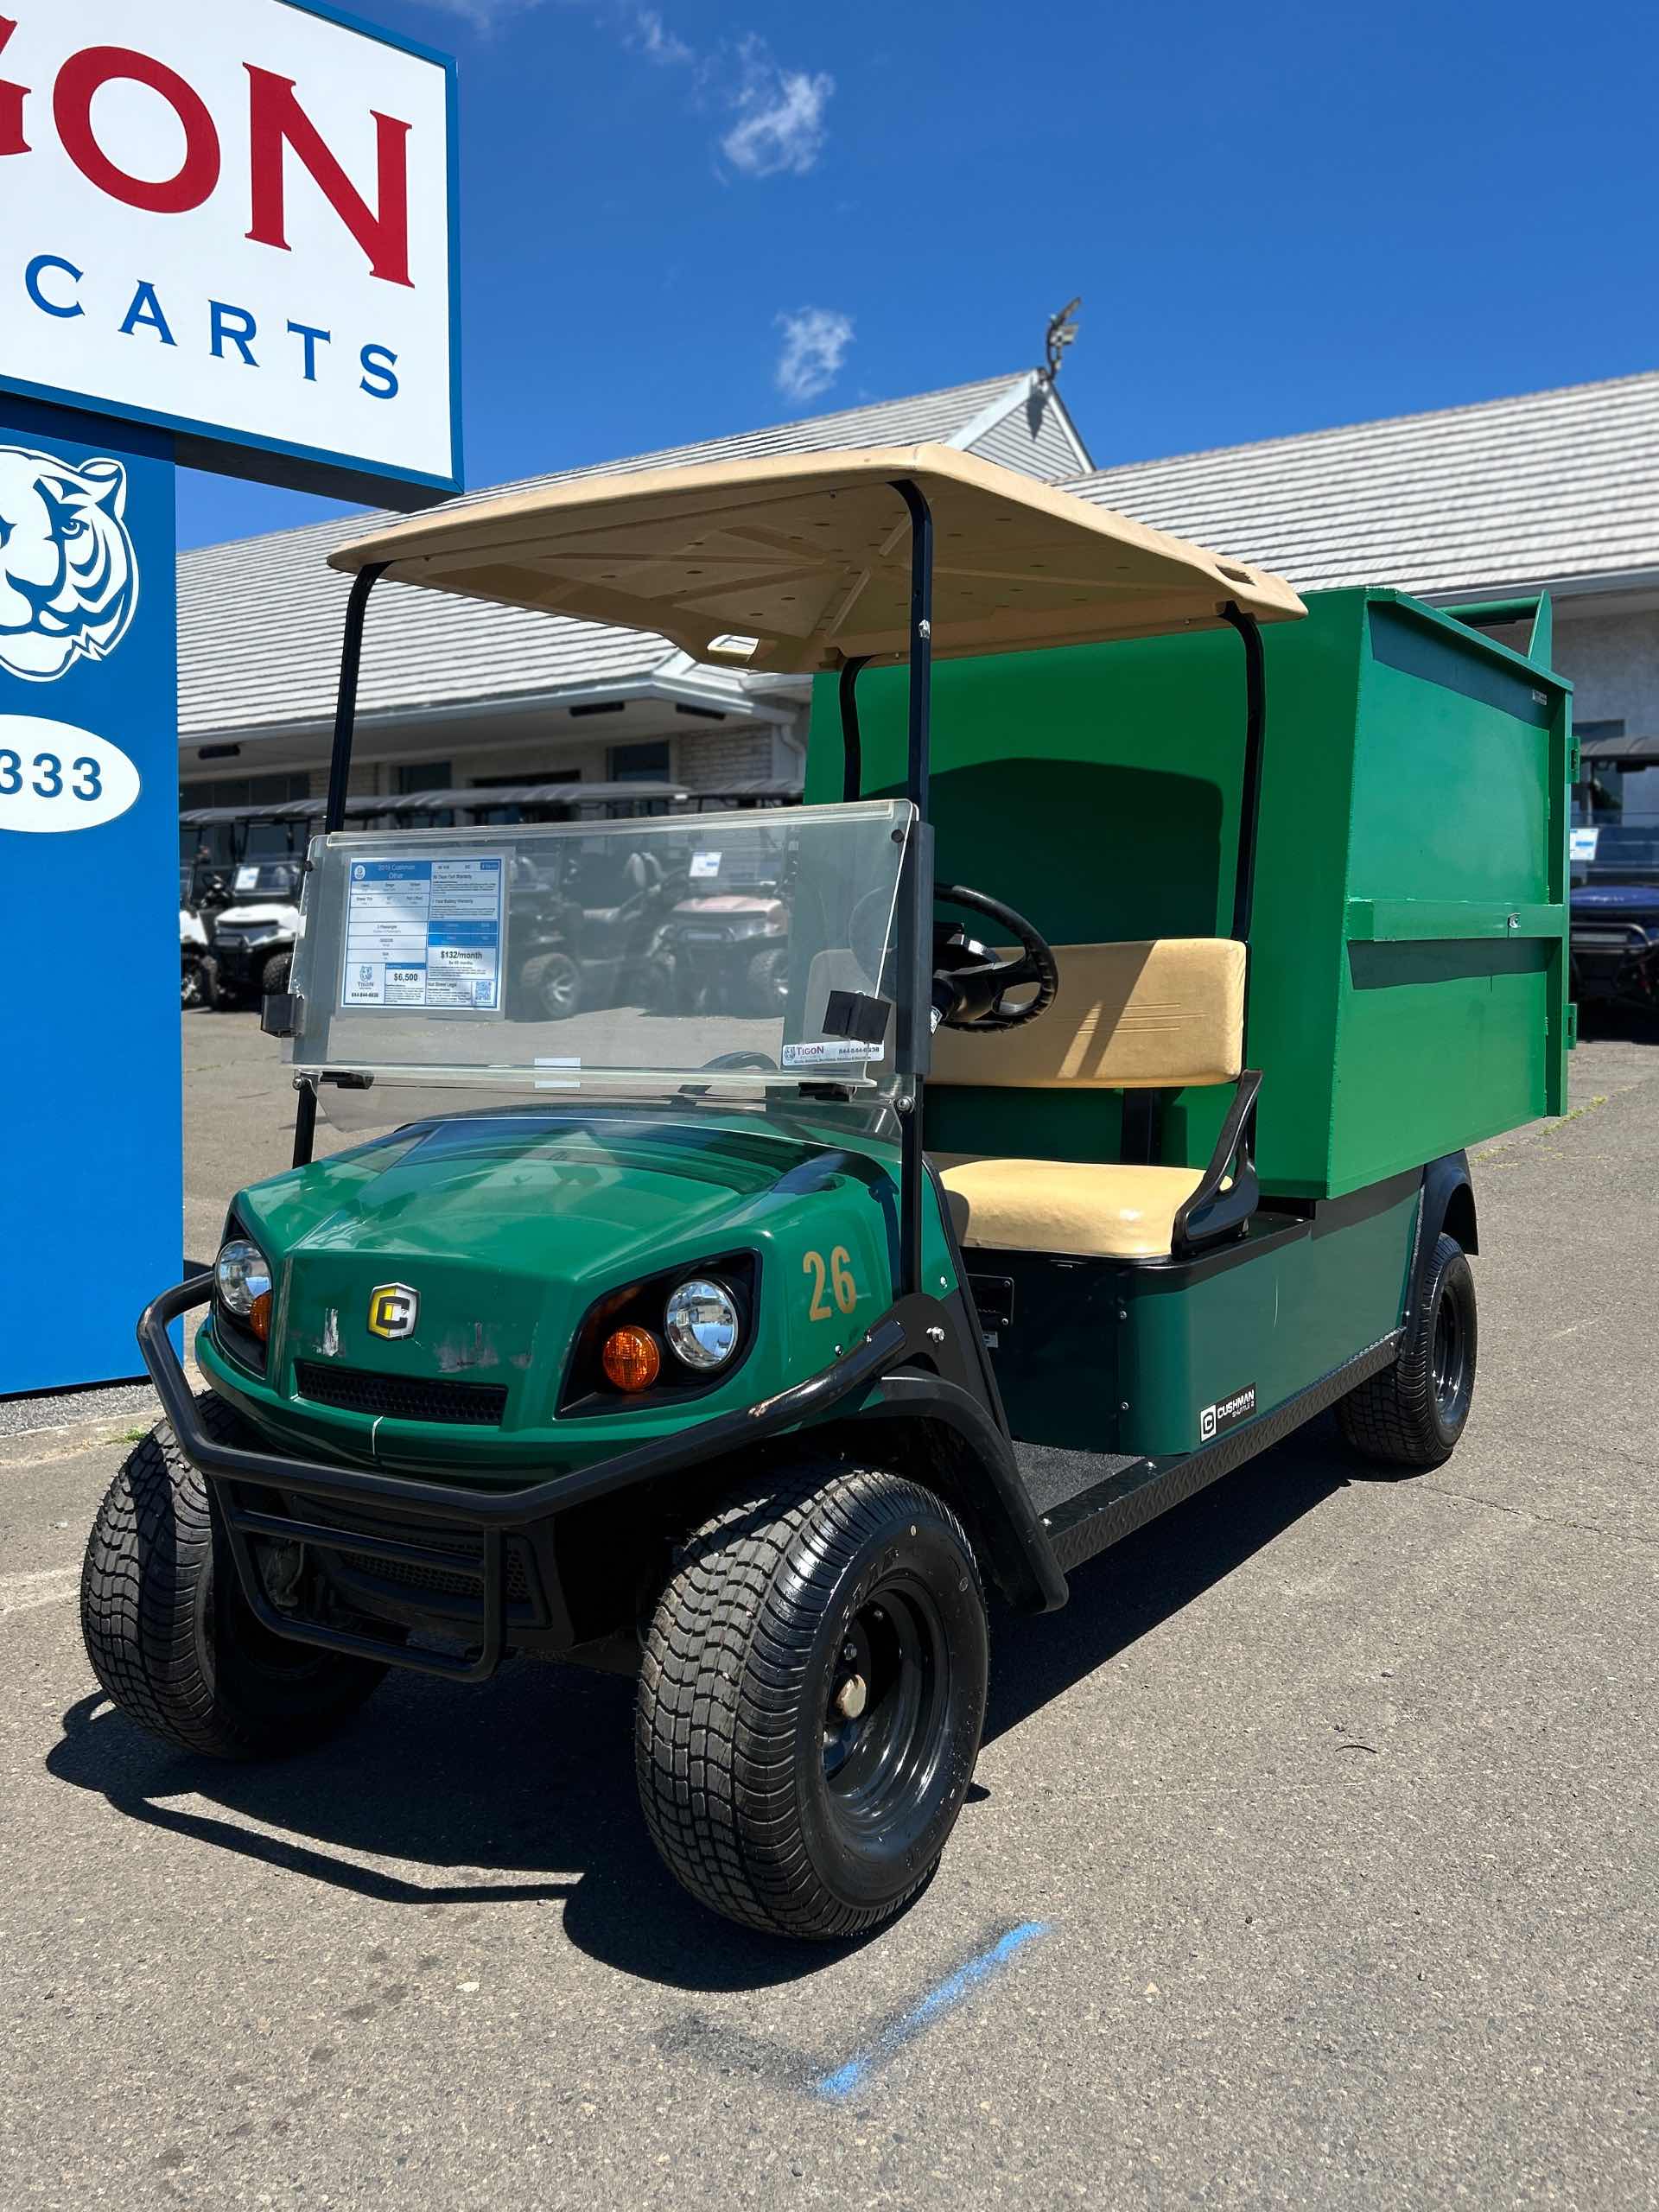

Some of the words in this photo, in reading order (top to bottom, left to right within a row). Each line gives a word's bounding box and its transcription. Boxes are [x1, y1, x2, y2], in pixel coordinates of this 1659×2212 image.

[0, 16, 415, 289] ON
[25, 254, 399, 399] CARTS
[441, 950, 483, 960] $132/month
[393, 973, 418, 982] $6,500
[796, 1046, 824, 1056] TIGON
[803, 1245, 857, 1322] 26
[1217, 1389, 1254, 1419] CUSHMAN
